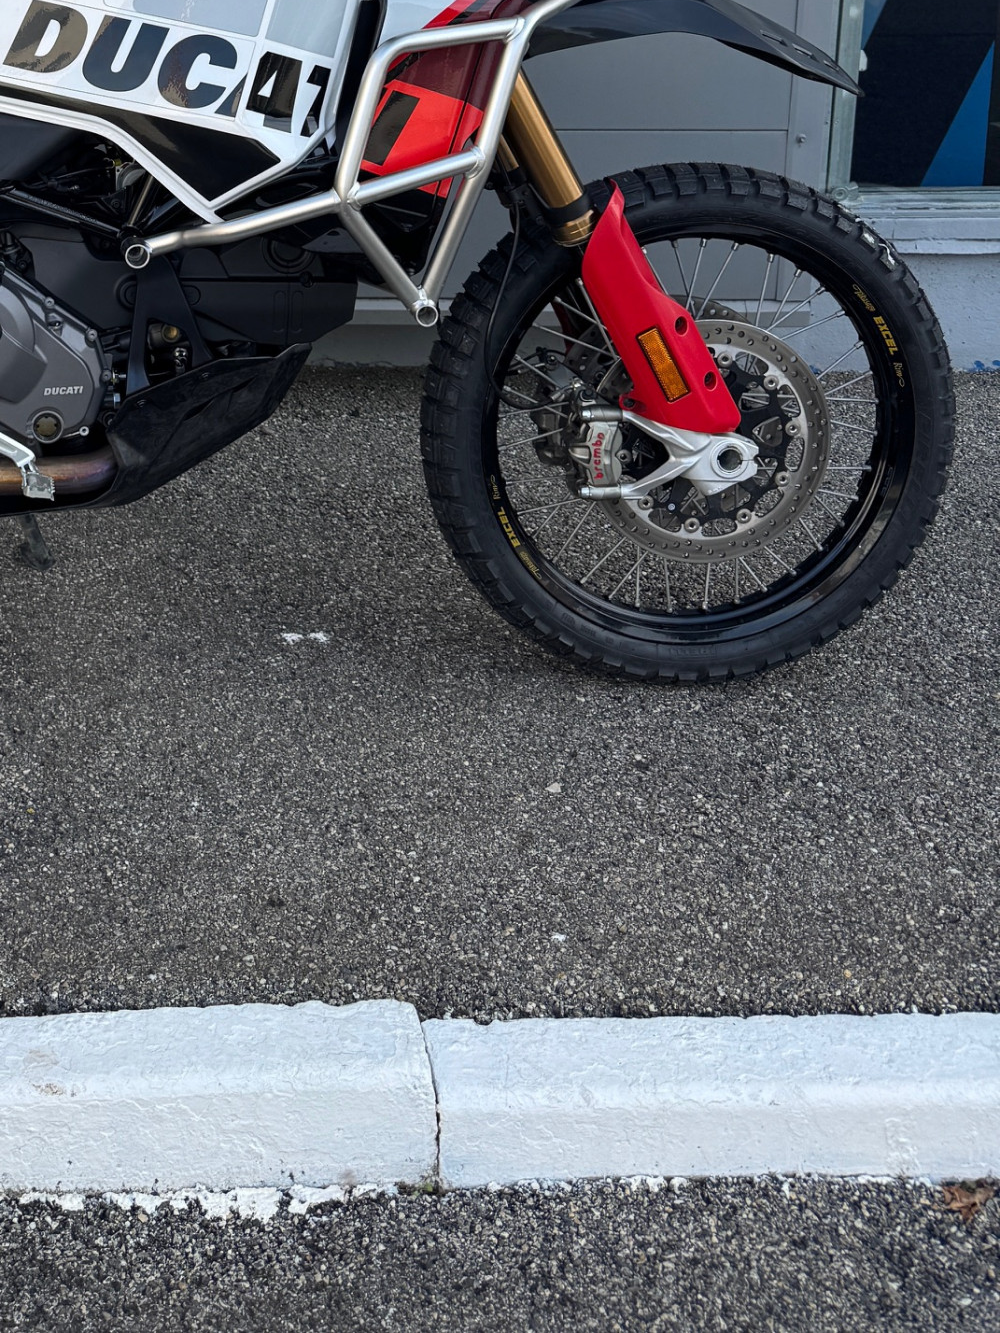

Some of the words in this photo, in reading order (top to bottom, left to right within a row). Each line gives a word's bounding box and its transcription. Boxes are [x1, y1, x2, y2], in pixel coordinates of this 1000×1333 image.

[873, 315, 899, 356] EXCEL
[43, 385, 84, 396] DUCATI
[591, 432, 605, 479] brembo
[498, 506, 521, 548] EXCEL
